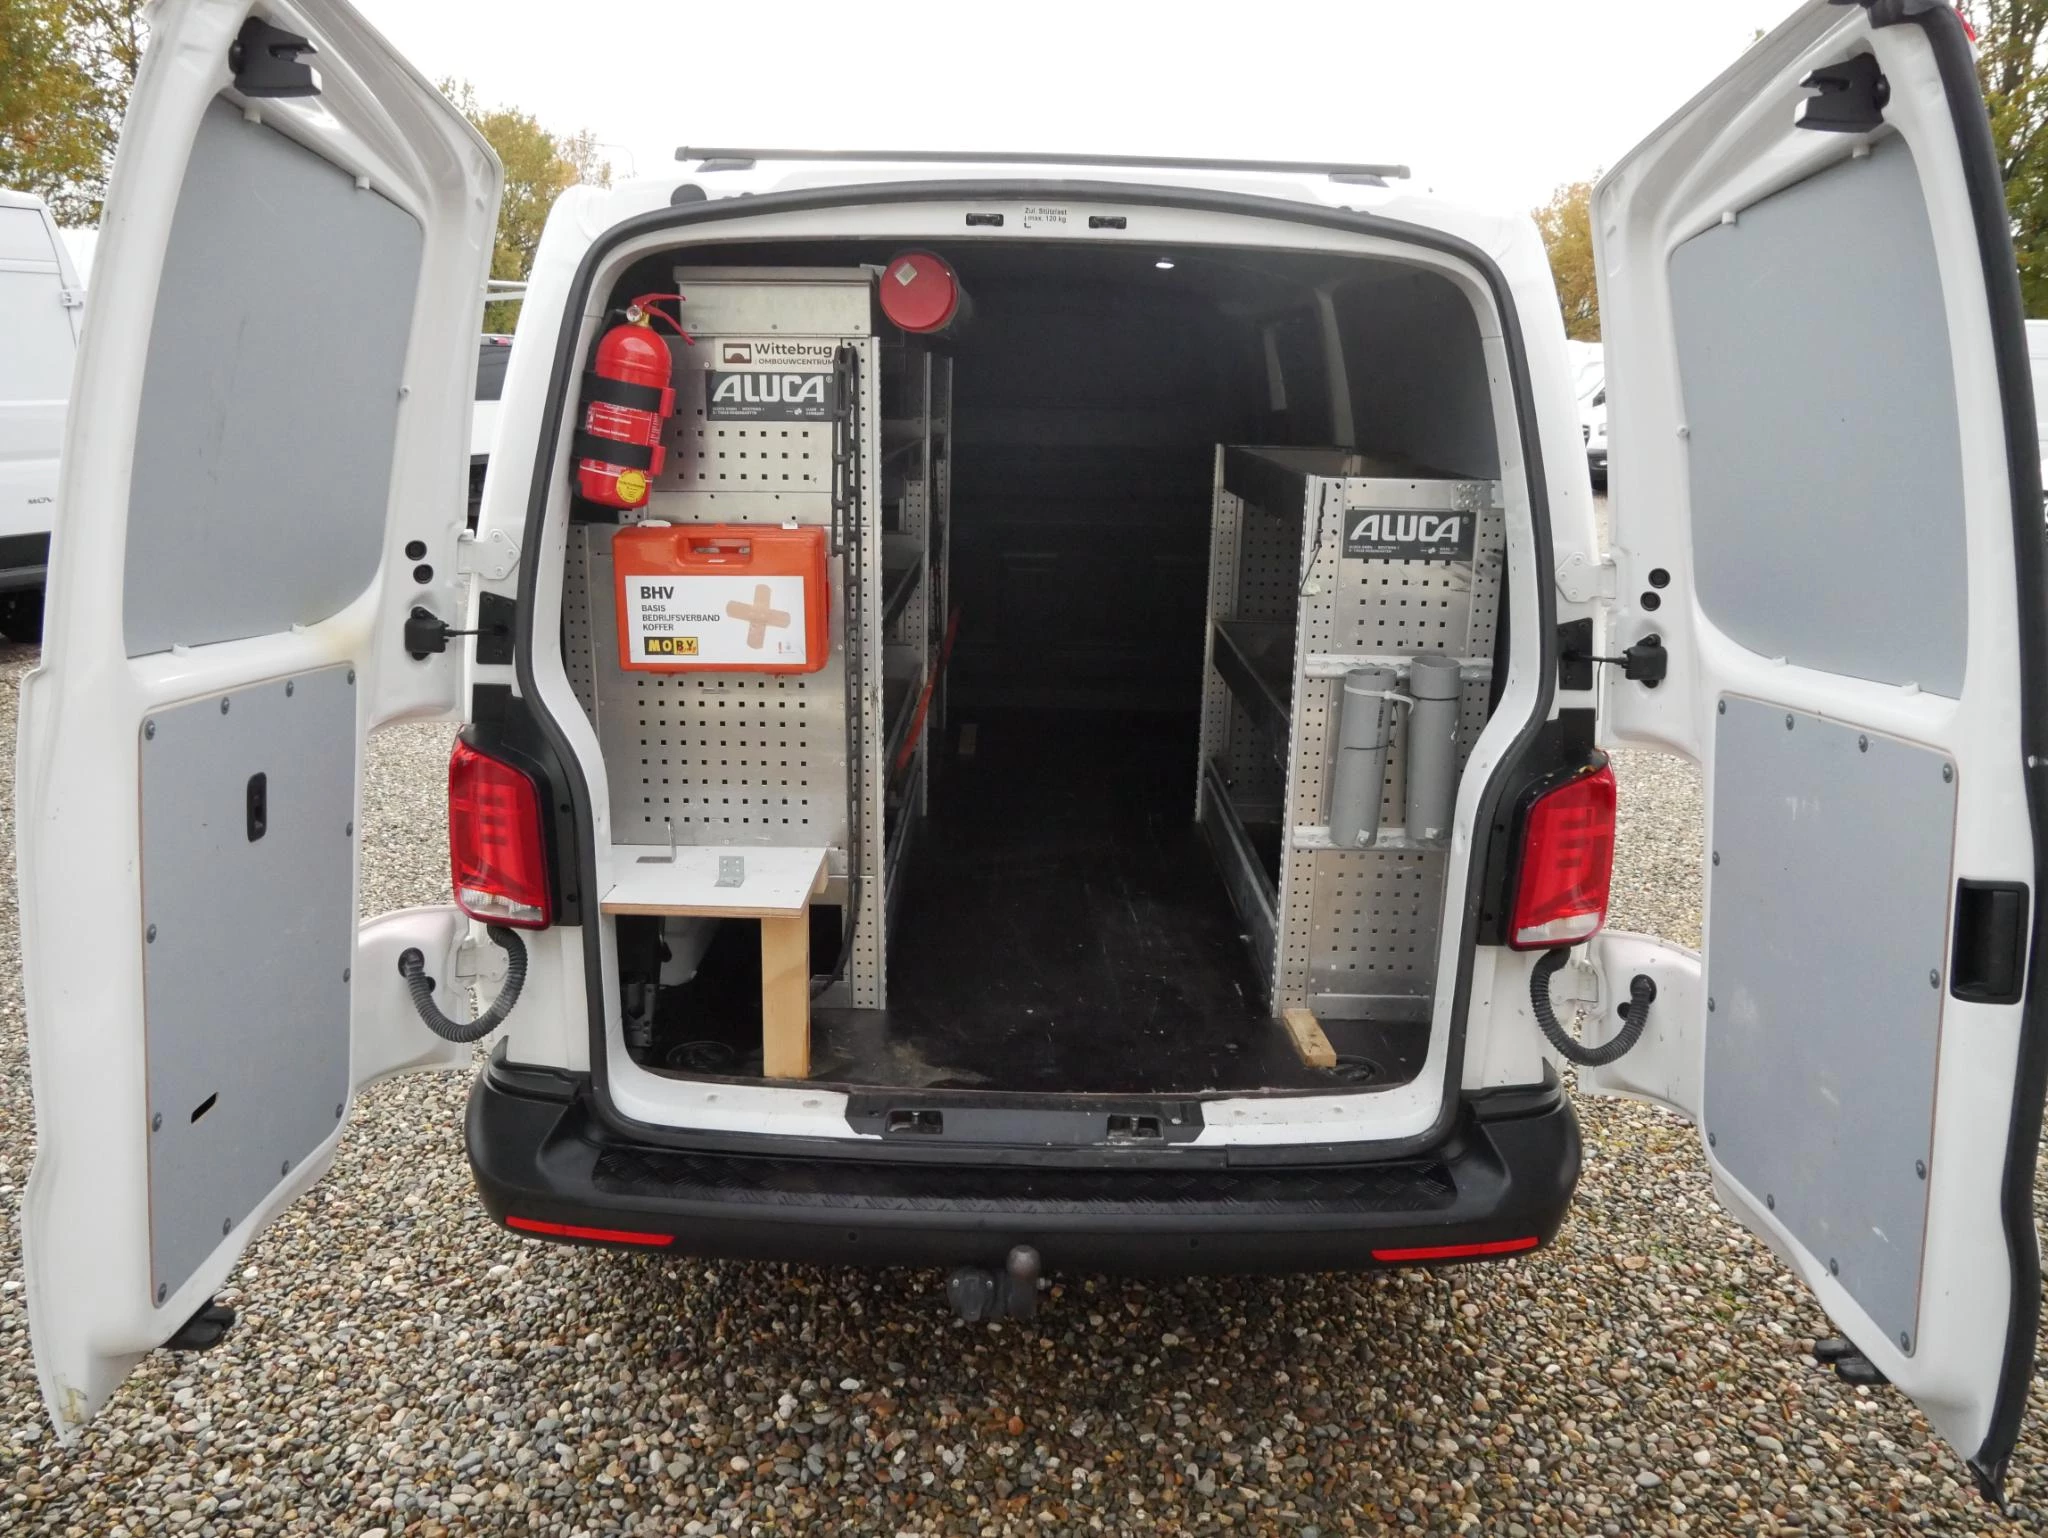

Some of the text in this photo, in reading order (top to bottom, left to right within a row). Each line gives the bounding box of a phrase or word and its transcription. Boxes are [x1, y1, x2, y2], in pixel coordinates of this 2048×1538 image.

[1058, 216, 1067, 224] kg
[755, 342, 832, 358] Wittebrug
[712, 374, 824, 403] ALUCA
[1350, 514, 1461, 543] ALUCA
[640, 586, 674, 599] BHV
[641, 604, 666, 612] BASIS
[642, 613, 720, 622] BEDRIJFSVERBAND
[642, 623, 674, 631] KOFFER
